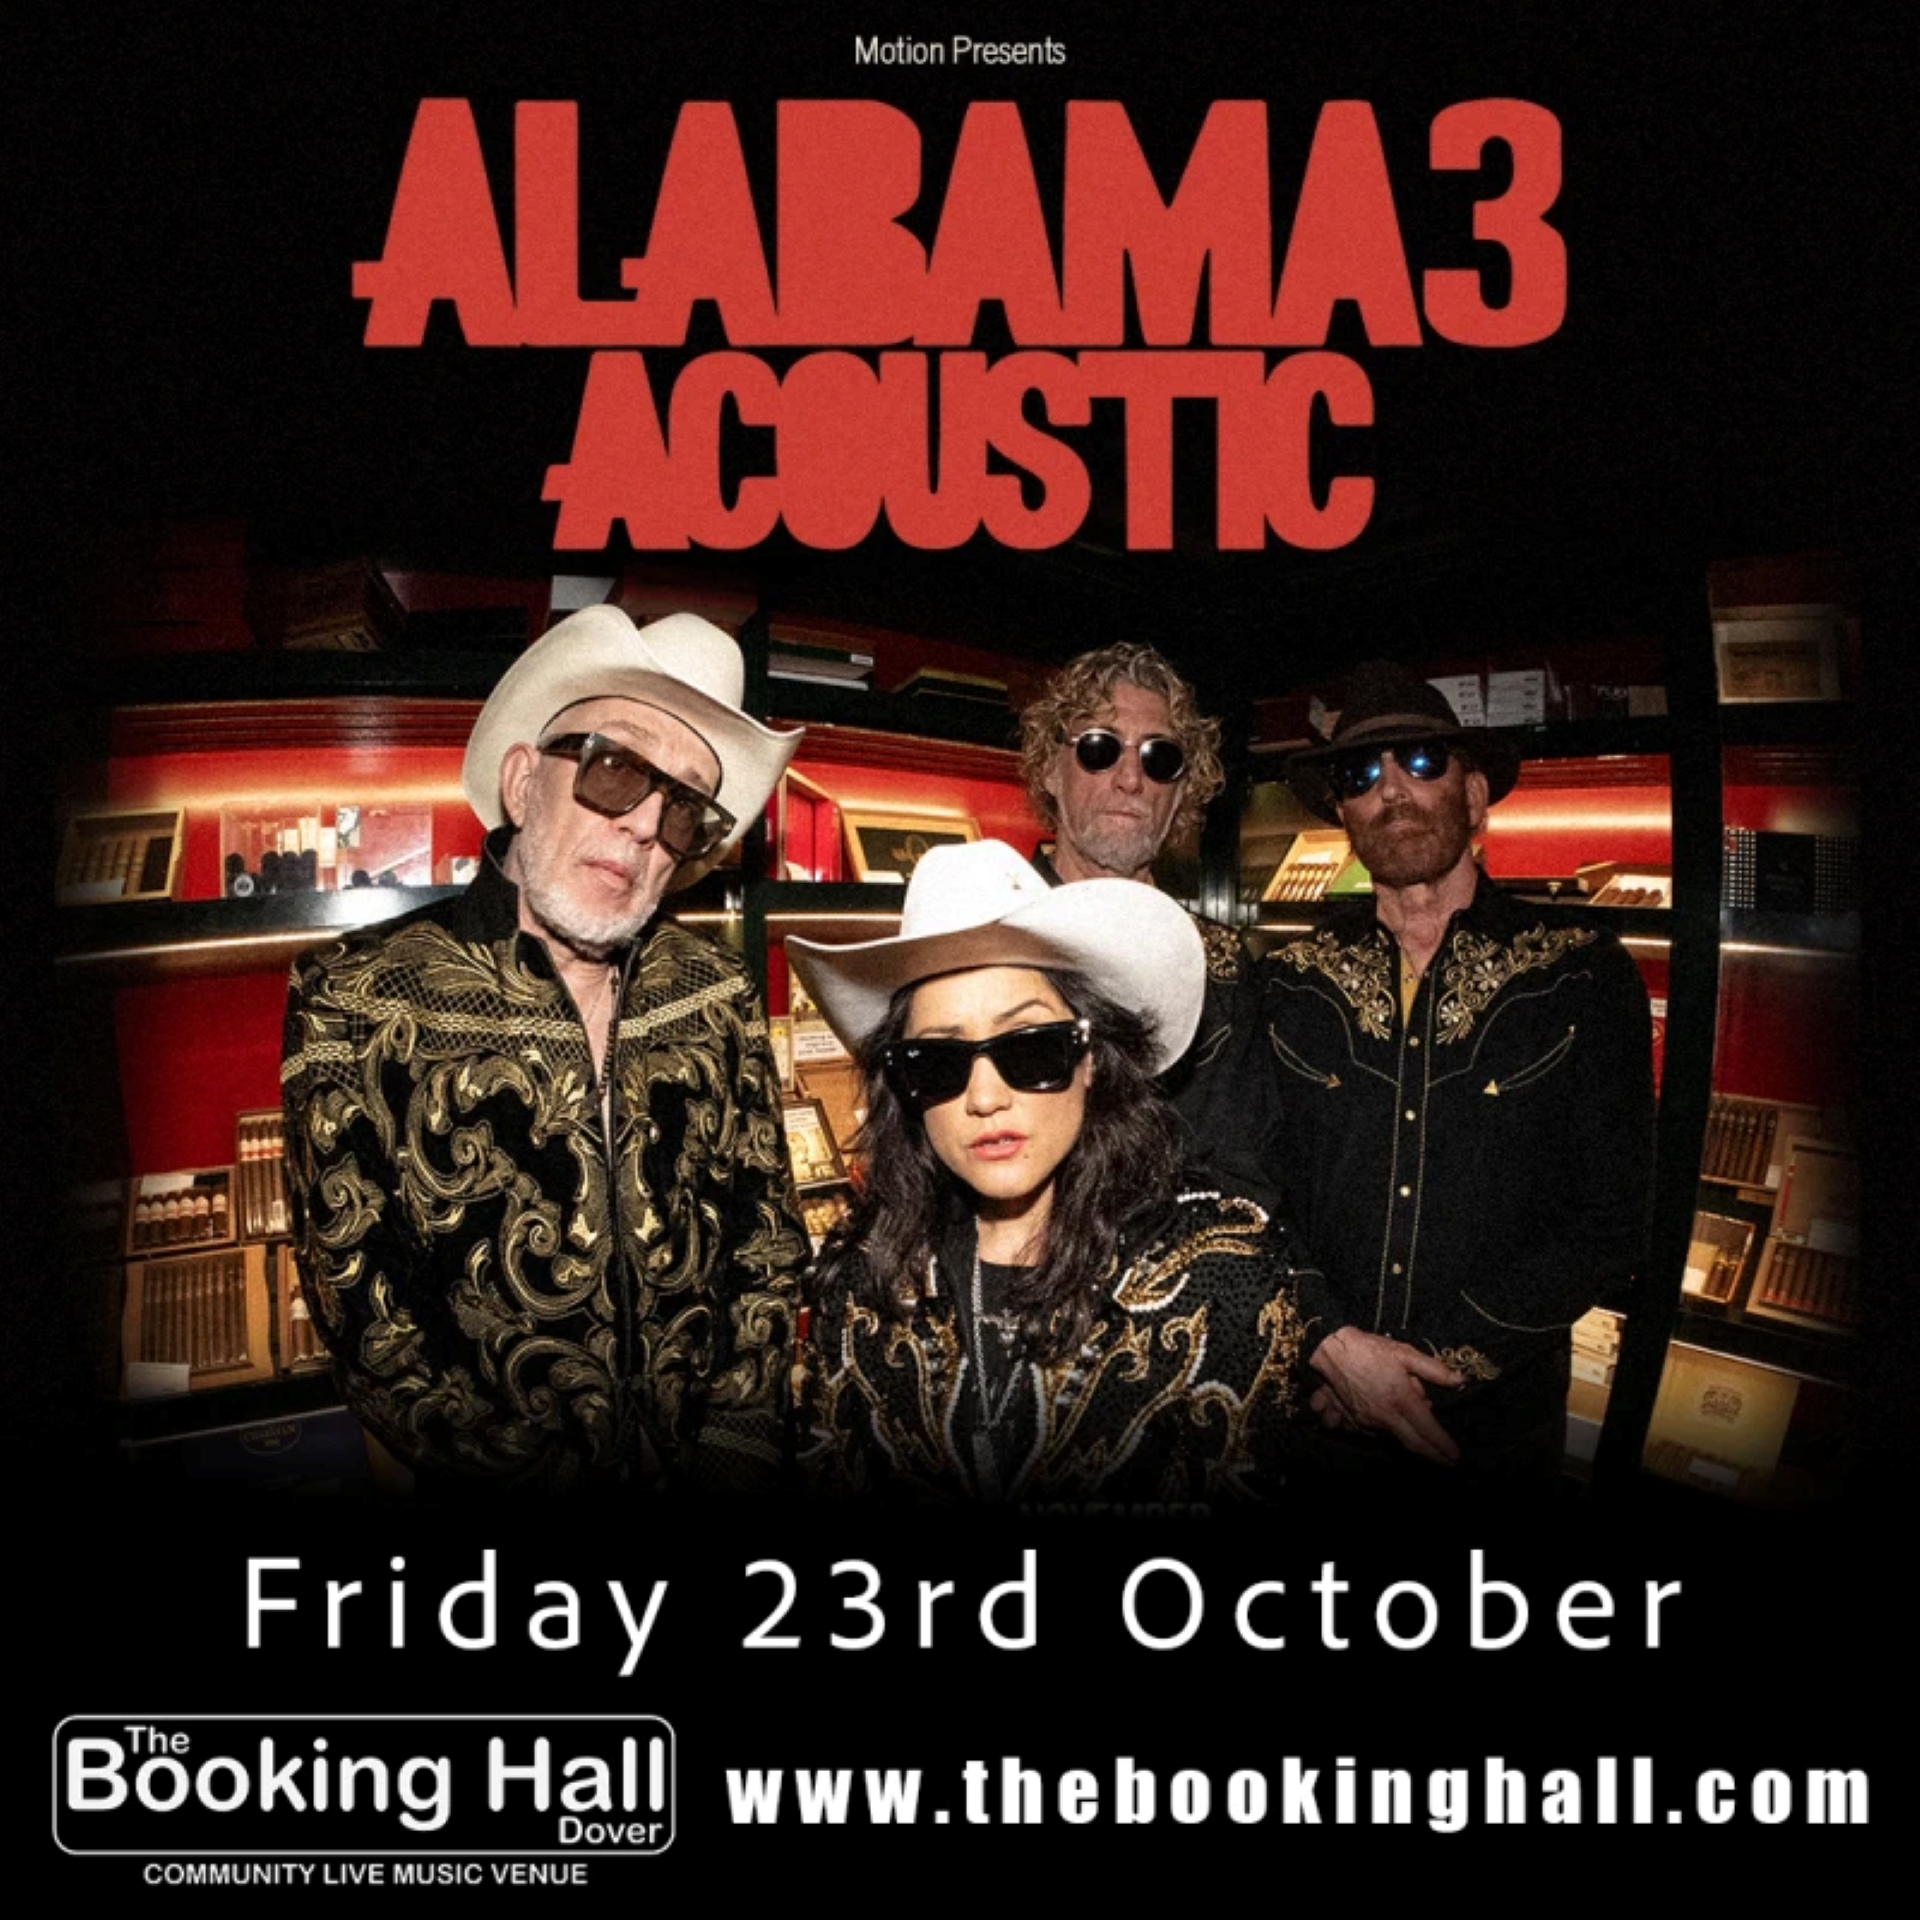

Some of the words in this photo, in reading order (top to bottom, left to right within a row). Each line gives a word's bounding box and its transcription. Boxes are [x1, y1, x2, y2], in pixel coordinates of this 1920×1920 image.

[855, 35, 945, 65] Motion
[953, 35, 1066, 65] Presents
[541, 351, 1375, 551] ACOUSTIC
[247, 1548, 668, 1677] Friday
[742, 1548, 1037, 1651] 23rd
[1121, 1548, 1682, 1651] October
[124, 1726, 190, 1754] The
[67, 1736, 453, 1832] Booking
[488, 1736, 665, 1813] Hall
[725, 1756, 1869, 1834] www.thebookinghall.com
[558, 1815, 664, 1846] Dover
[143, 1863, 316, 1885] COMMUNITY
[323, 1863, 385, 1885] LIVE
[393, 1863, 483, 1885] MUSIC
[490, 1863, 588, 1885] VENUE
